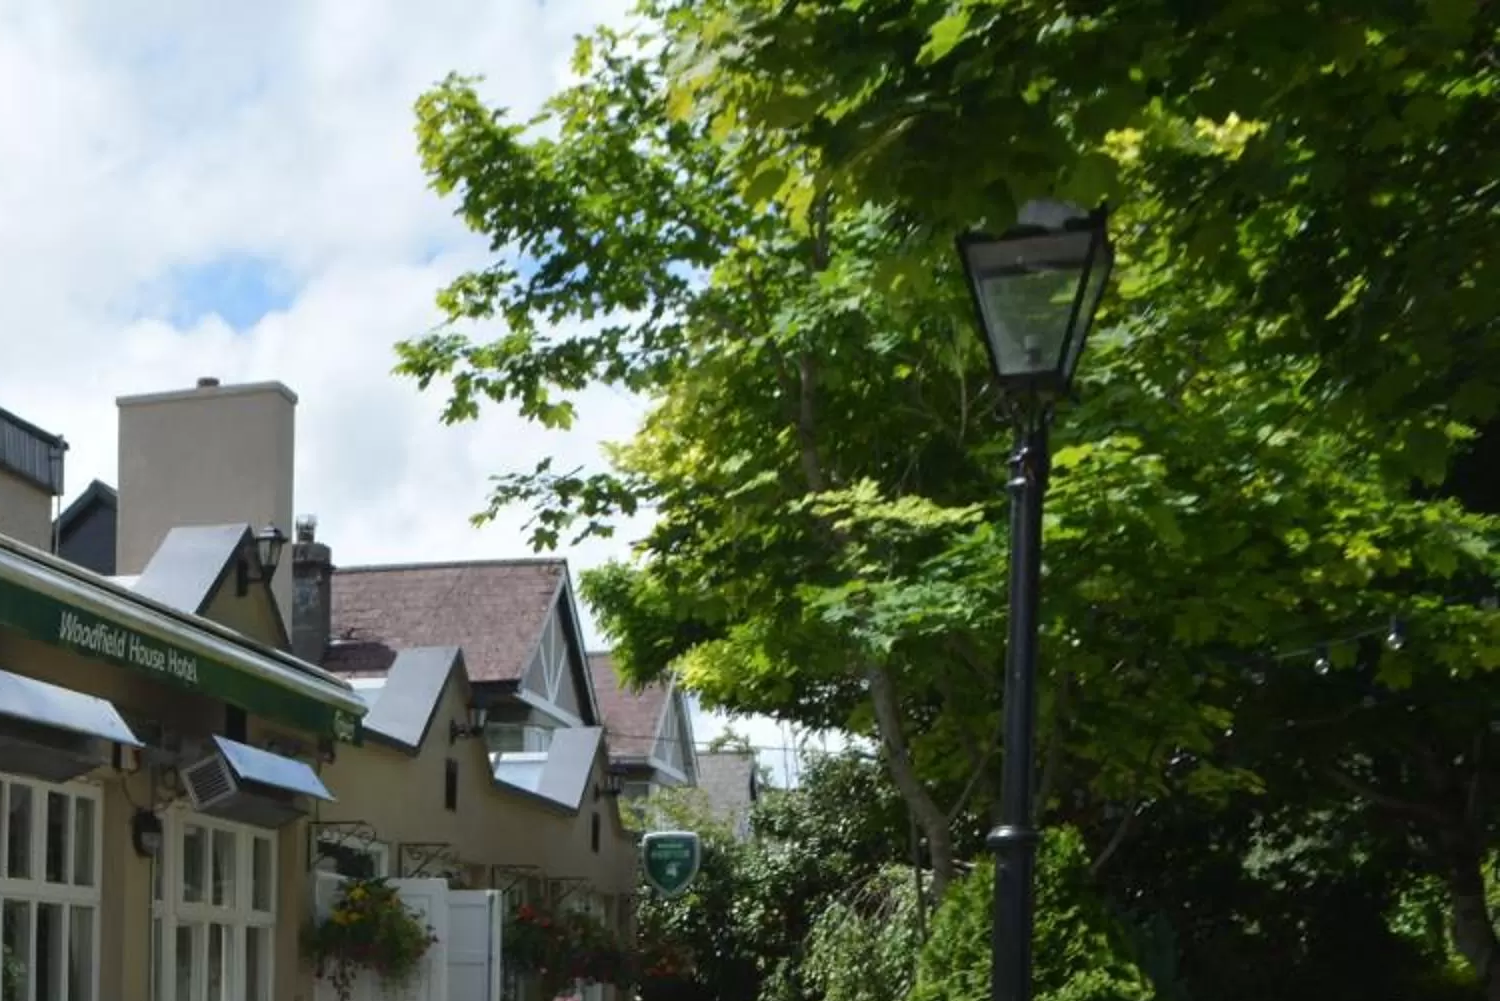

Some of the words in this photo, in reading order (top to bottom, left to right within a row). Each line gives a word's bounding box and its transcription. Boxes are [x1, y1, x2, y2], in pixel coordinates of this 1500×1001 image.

[59, 611, 126, 657] Woodfield
[129, 633, 165, 671] House
[167, 648, 198, 684] Hotel
